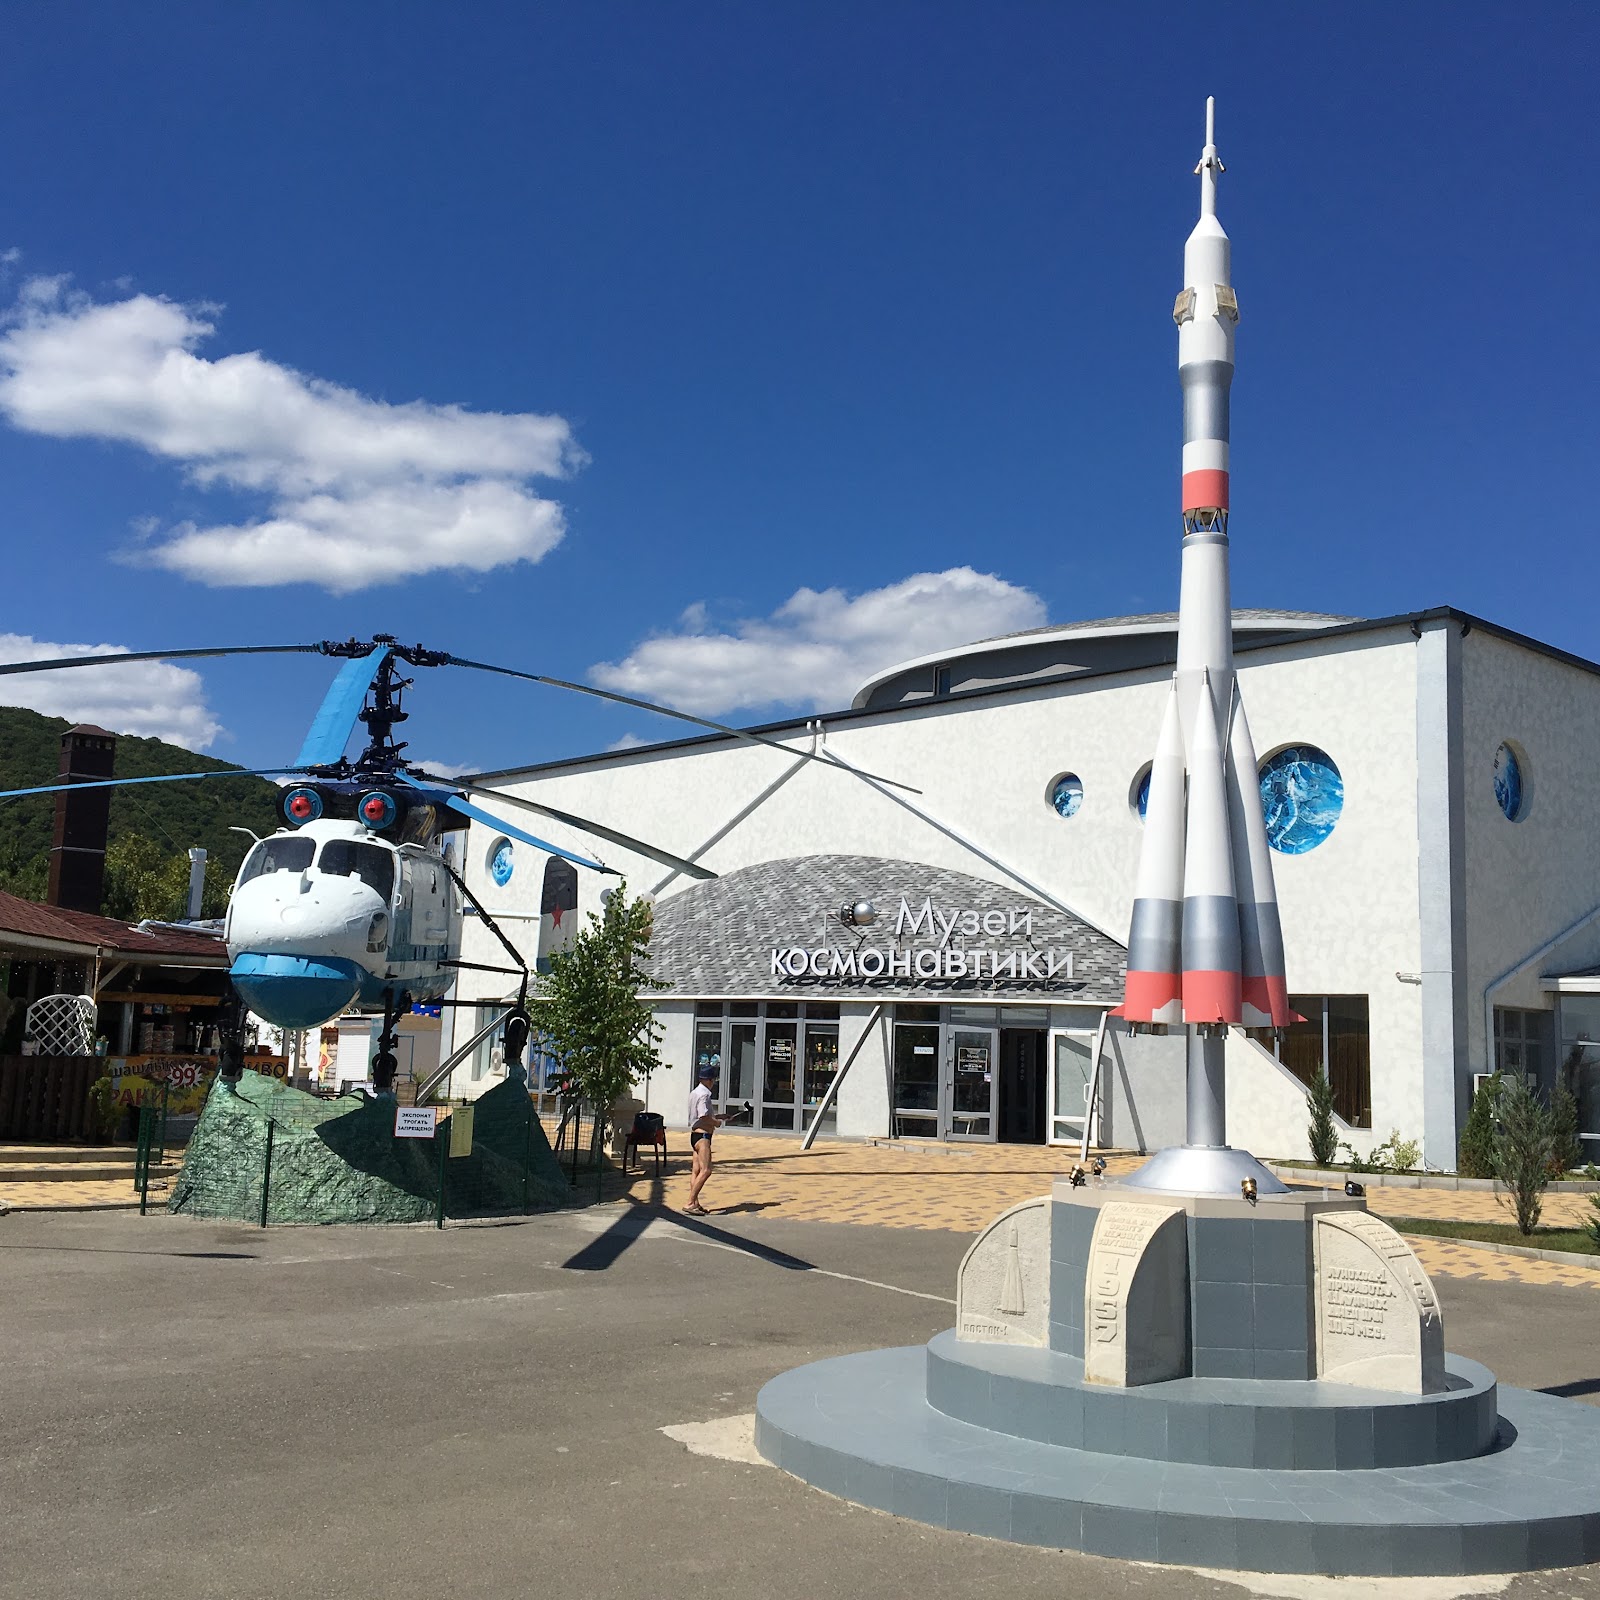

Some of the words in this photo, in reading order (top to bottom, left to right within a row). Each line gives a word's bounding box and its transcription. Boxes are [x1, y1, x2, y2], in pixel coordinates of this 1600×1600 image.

[896, 896, 1032, 948] Музей
[172, 1067, 196, 1087] 99
[244, 1061, 286, 1078] ИВО
[1094, 1257, 1121, 1343] 1957
